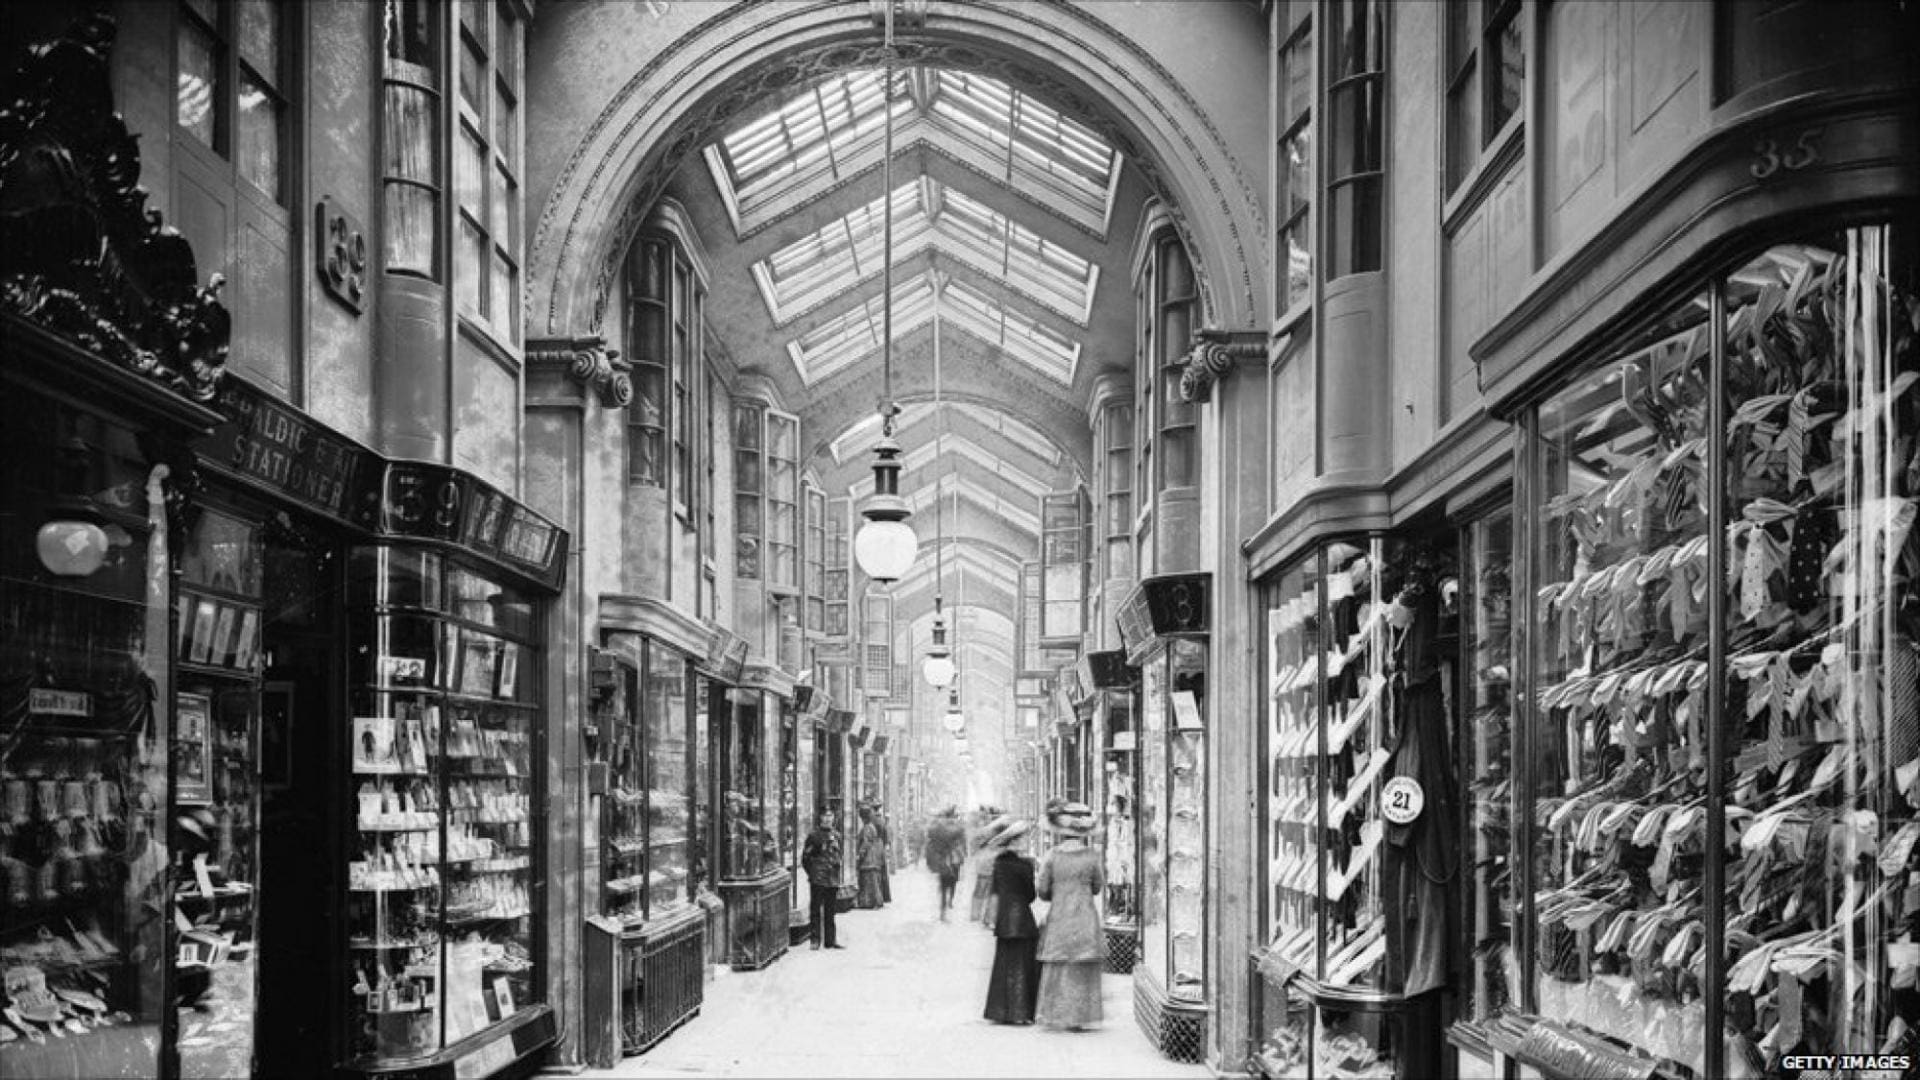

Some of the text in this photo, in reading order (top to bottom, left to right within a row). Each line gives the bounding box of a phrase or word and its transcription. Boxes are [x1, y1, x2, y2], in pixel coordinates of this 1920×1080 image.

[1749, 129, 1821, 178] 35
[232, 434, 344, 508] STATIONER
[395, 473, 460, 527] 39
[1392, 790, 1411, 810] 21
